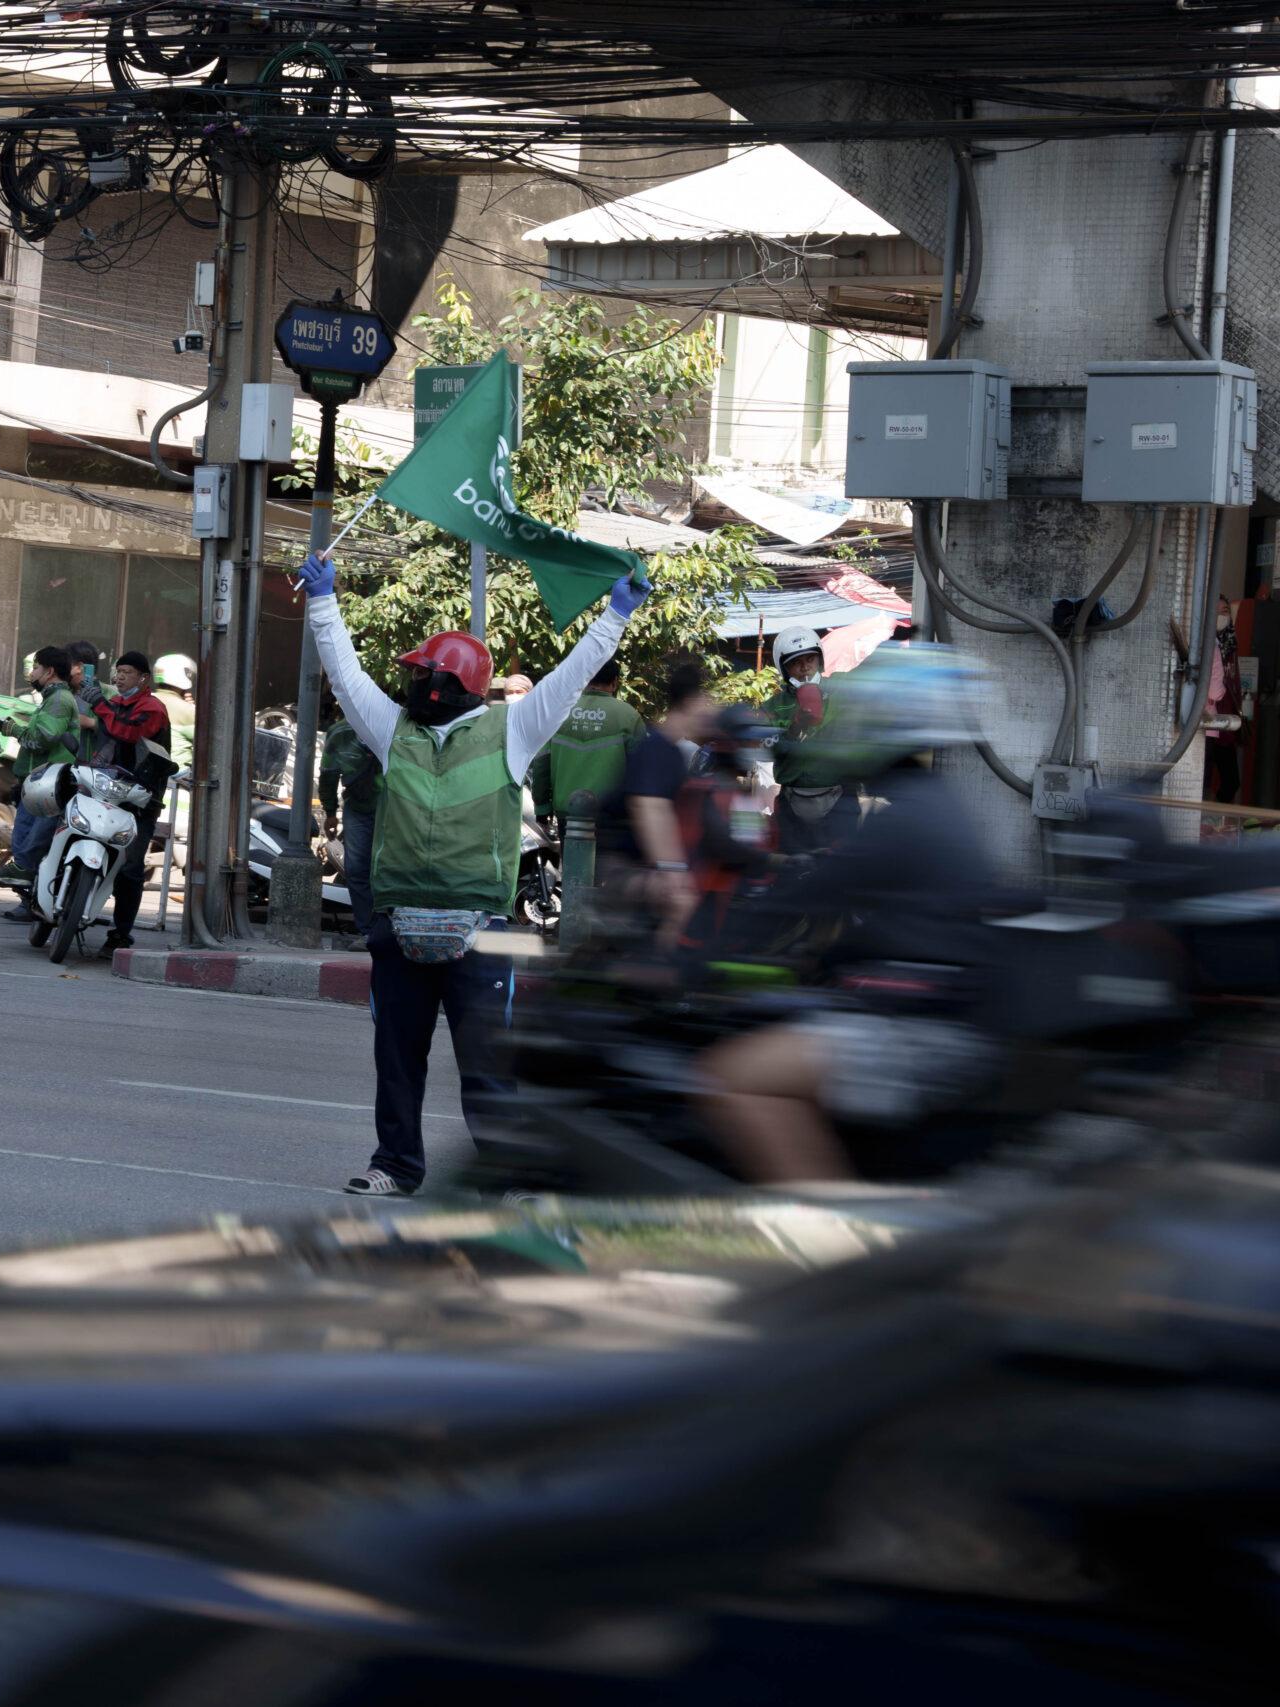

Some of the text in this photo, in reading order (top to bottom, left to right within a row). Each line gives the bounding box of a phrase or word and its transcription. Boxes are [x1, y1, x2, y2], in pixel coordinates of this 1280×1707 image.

[292, 317, 342, 350] เพชรบุรี
[351, 325, 378, 356] 39
[292, 339, 324, 352] Phetchaburi
[571, 707, 607, 721] Grab
